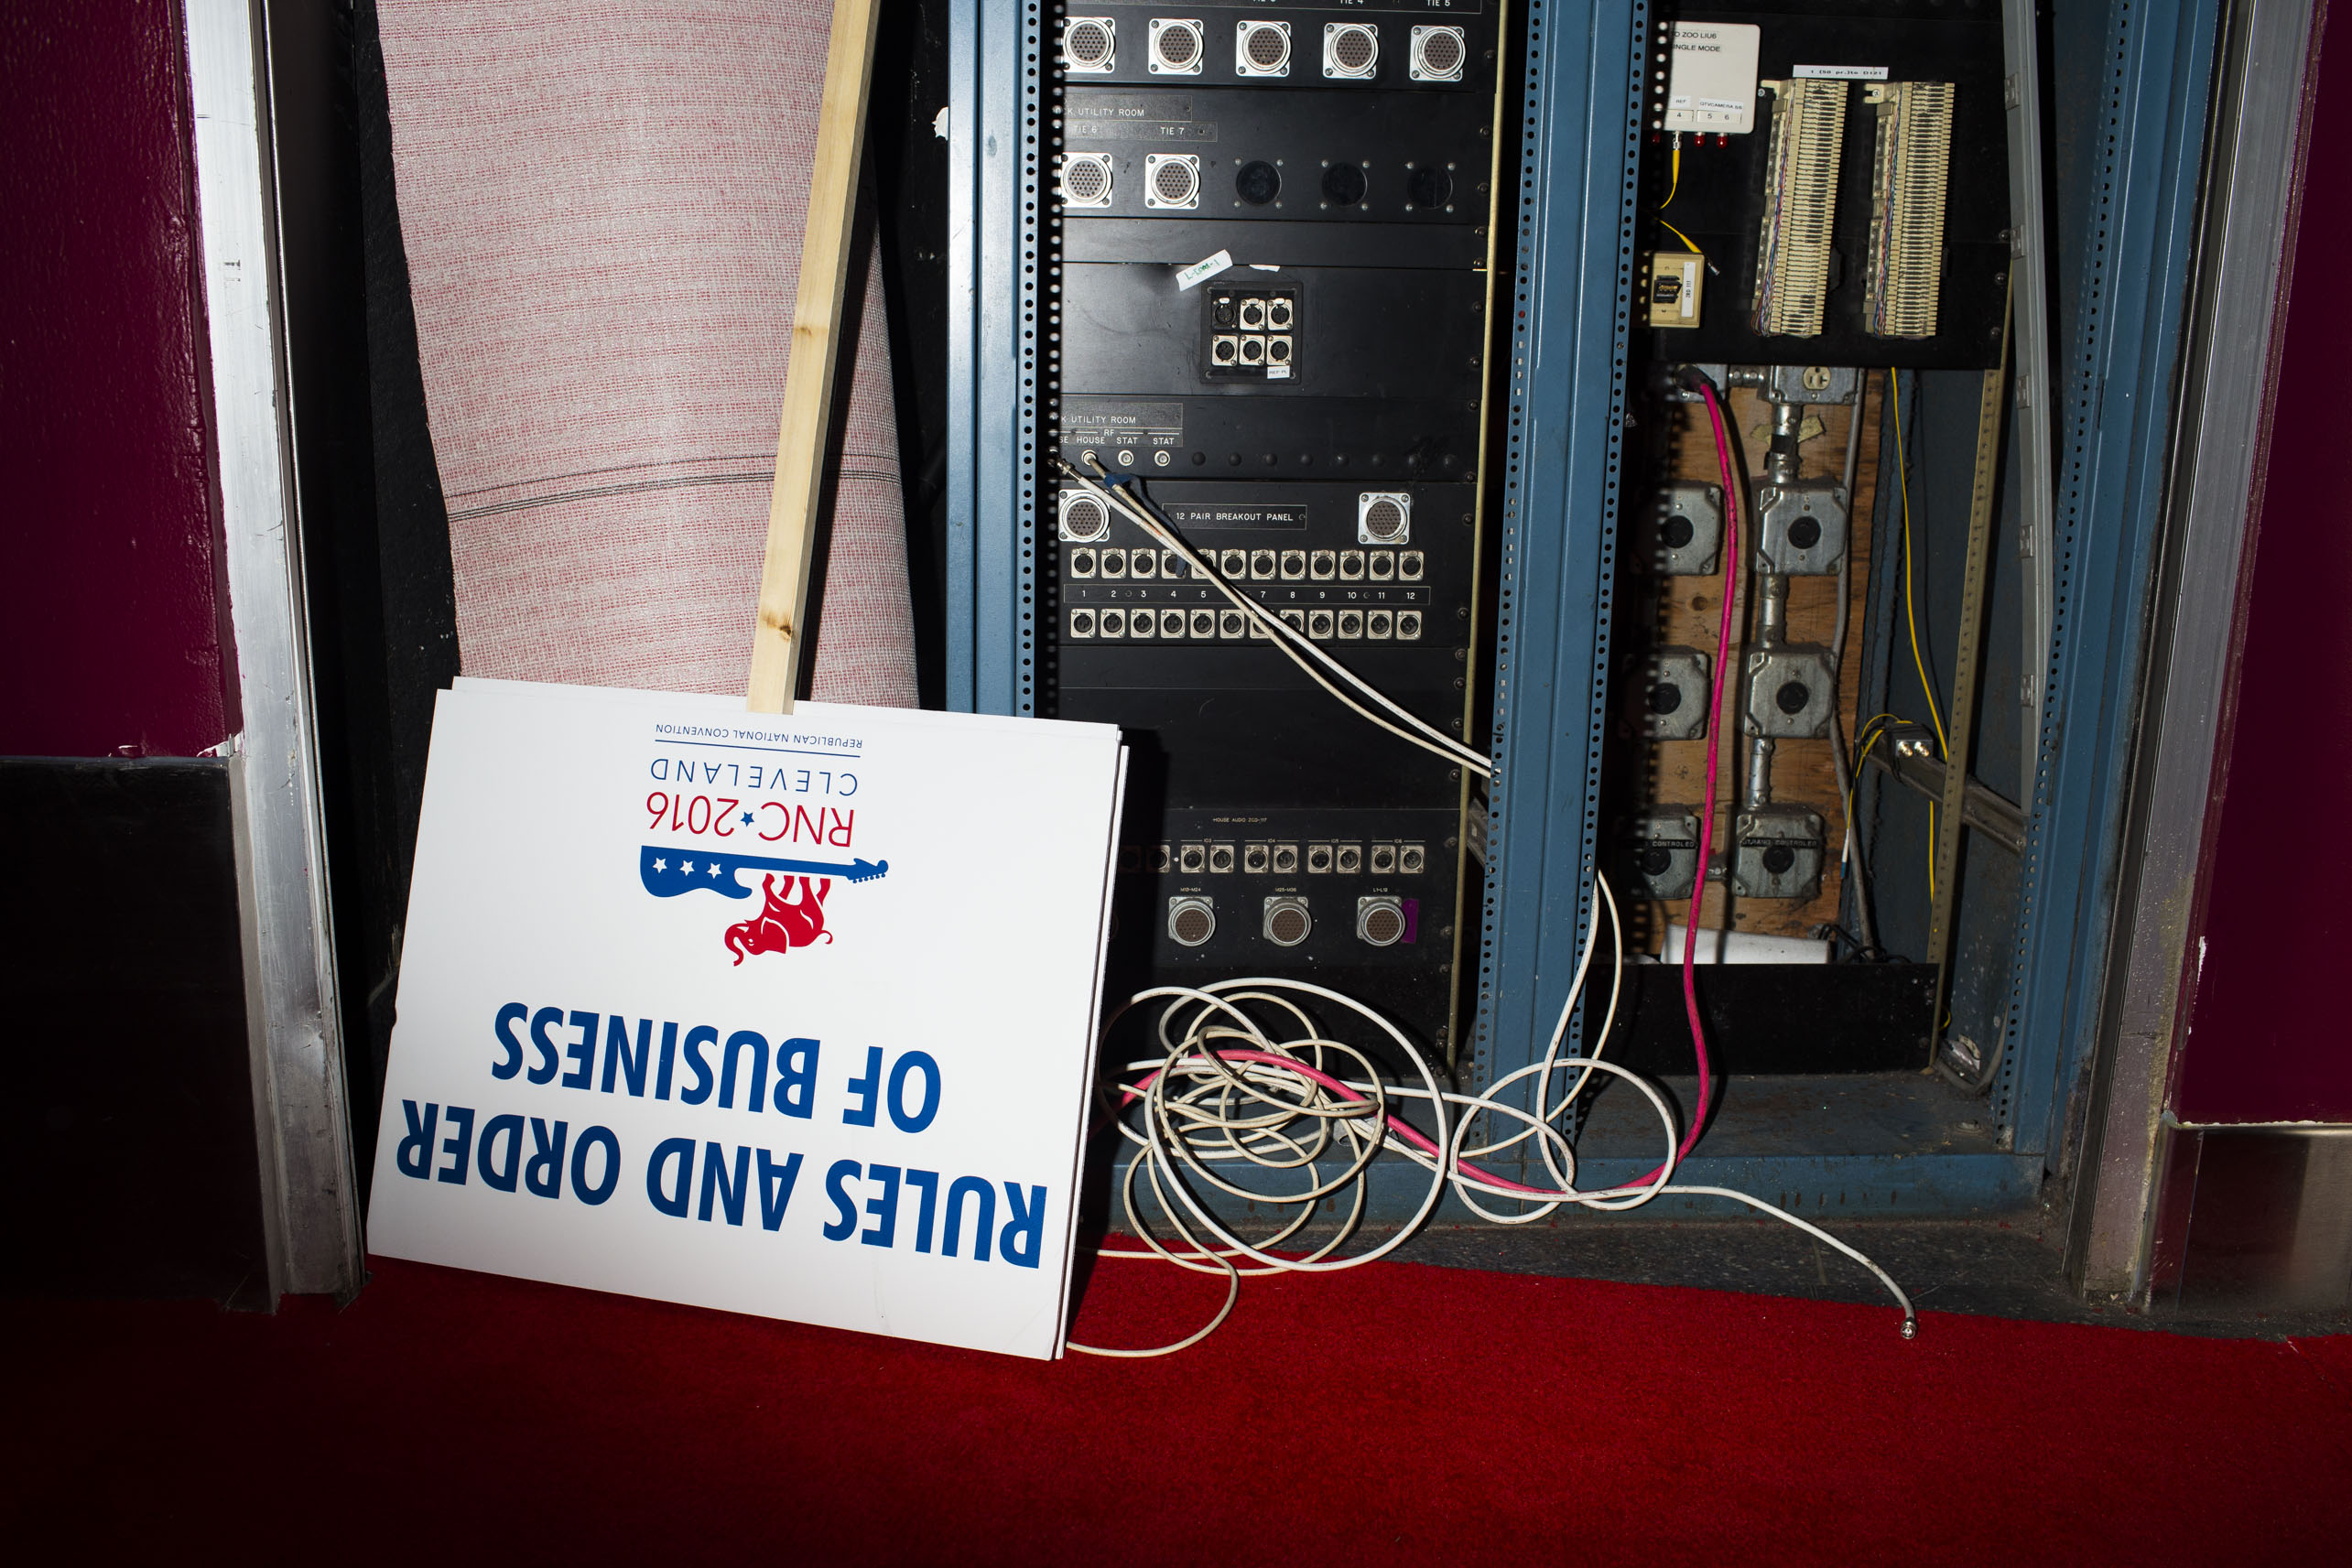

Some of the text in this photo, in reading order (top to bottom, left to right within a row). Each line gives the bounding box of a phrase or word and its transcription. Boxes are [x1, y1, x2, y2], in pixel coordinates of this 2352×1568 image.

[1671, 43, 1696, 51] INGLE
[1078, 107, 1114, 116] UTILITY
[1118, 108, 1144, 117] ROOM
[1160, 126, 1185, 135] TIE 7
[1071, 416, 1106, 424] UTILITY
[1103, 428, 1114, 437] RF
[1076, 436, 1105, 445] HOUSE
[1116, 437, 1138, 445] STAT
[1153, 437, 1175, 445] STAT
[1176, 512, 1294, 522] 12 PAIR BREAKOUT PANEL
[1200, 590, 1207, 599] 5
[1260, 590, 1266, 599] 7
[1378, 591, 1385, 600] 11
[655, 723, 862, 749] REPUBLICAN NATIONAL CONVENTION
[650, 758, 858, 796] CLEVELAND
[646, 791, 854, 848] RNC 2016
[491, 1002, 941, 1134] OF BUSINESS
[396, 1098, 1048, 1270] RULES AND ORDER
